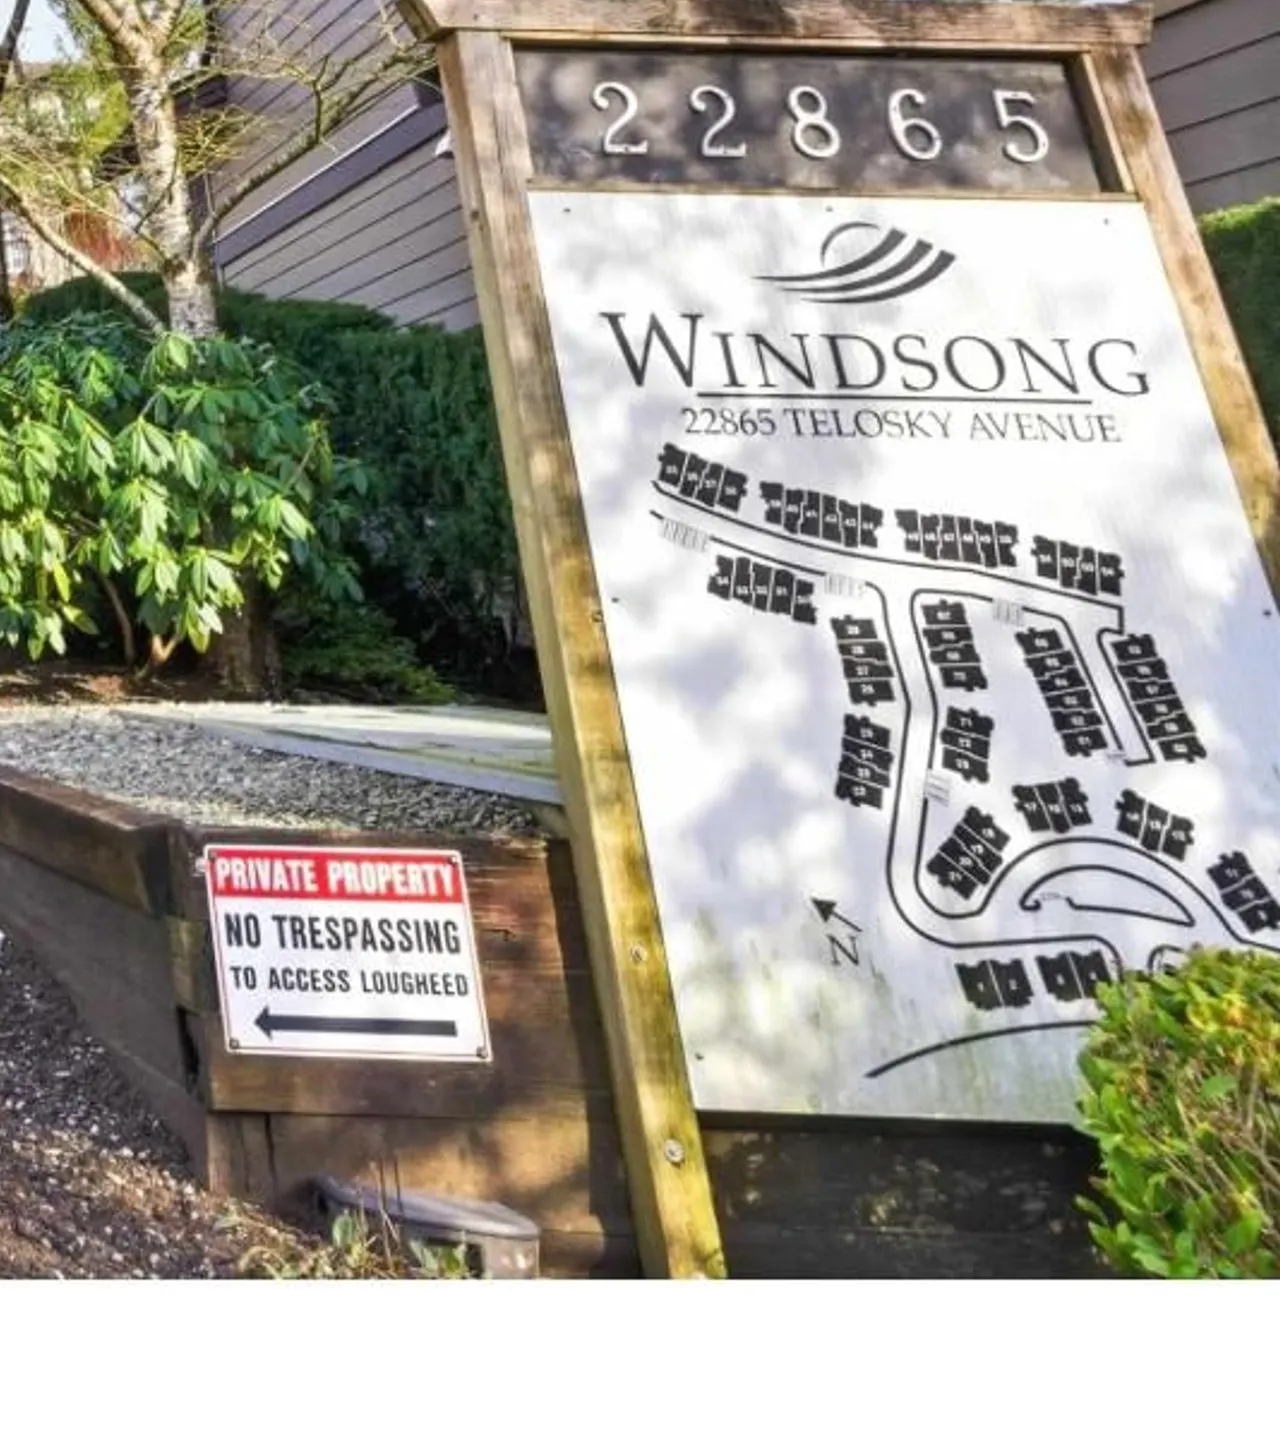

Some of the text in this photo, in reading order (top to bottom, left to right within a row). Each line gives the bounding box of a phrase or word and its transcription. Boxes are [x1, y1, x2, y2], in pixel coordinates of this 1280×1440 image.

[592, 82, 1048, 163] 22865
[600, 312, 1150, 398] WINDSONG
[682, 408, 1123, 444] 22865 TELOSKY AVENUE
[214, 857, 456, 896] PRIVATE PROPERTY
[224, 913, 461, 955] NO TRESPASSING
[229, 966, 469, 997] TO ACCESS LOUGHEED
